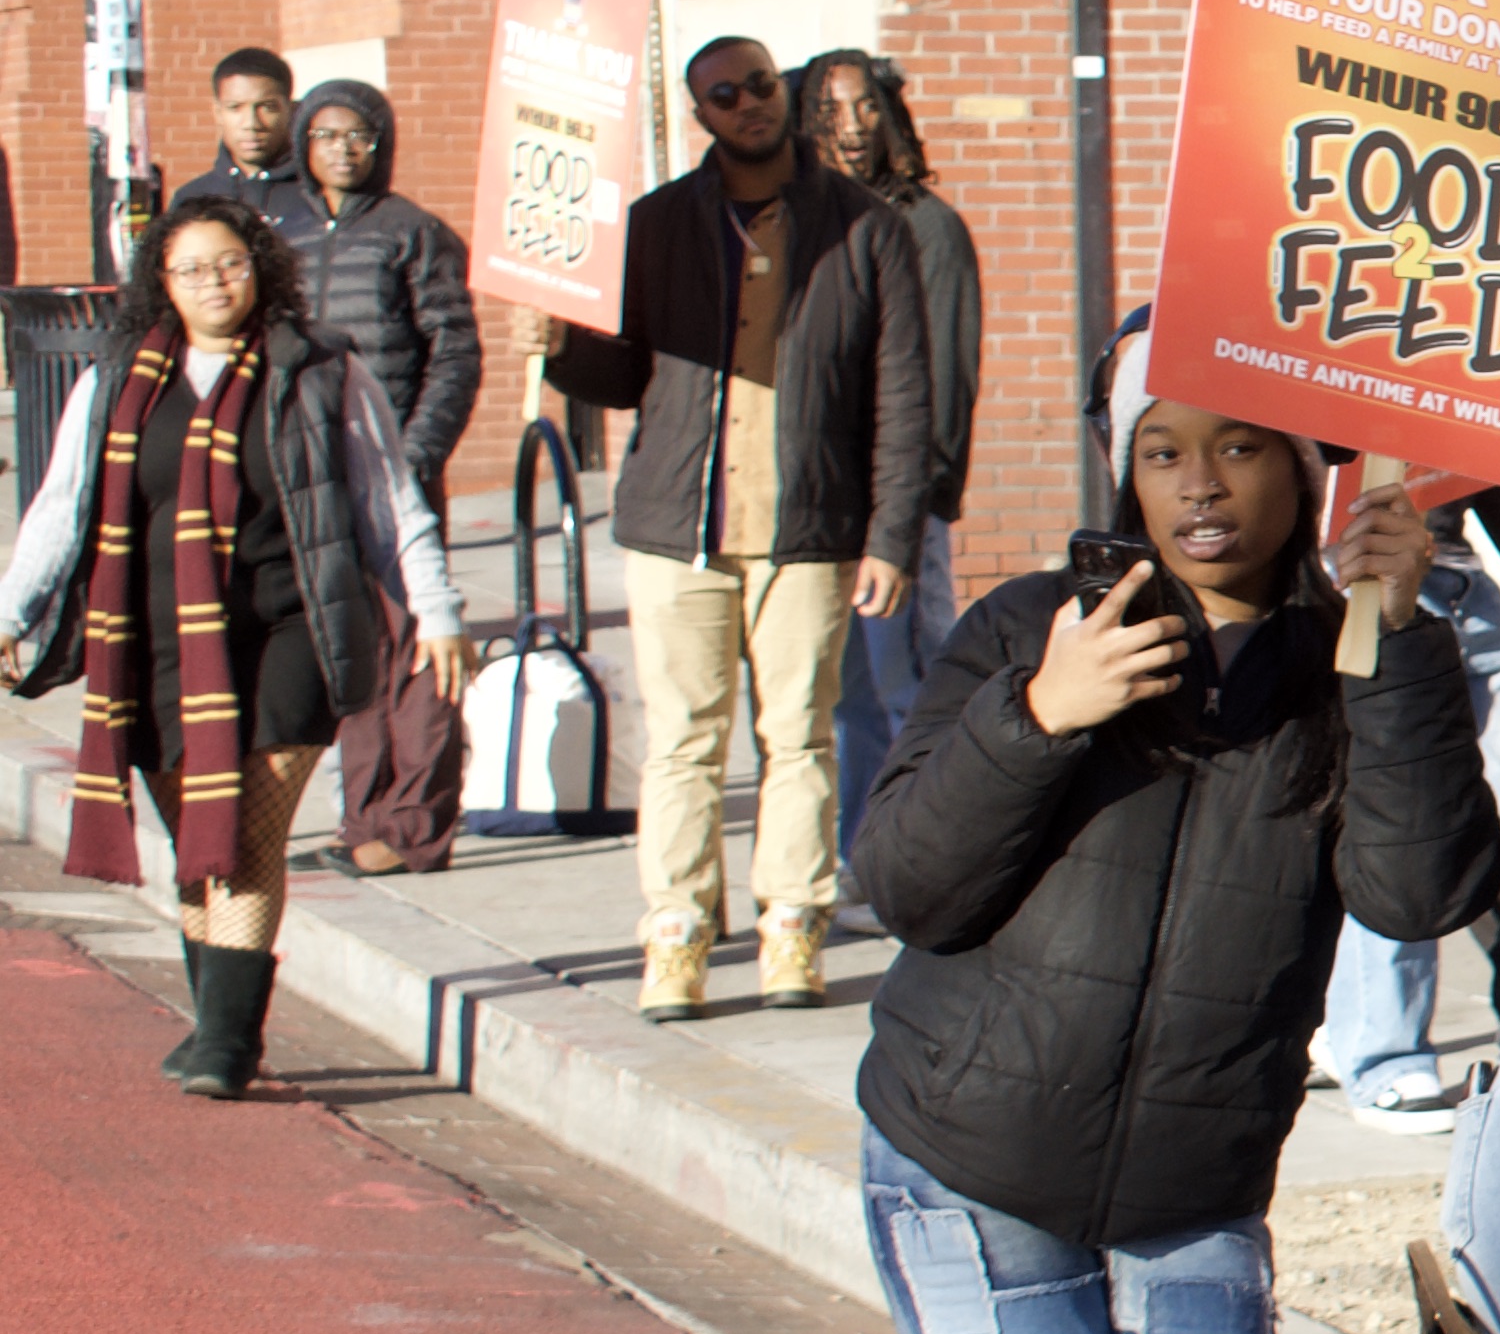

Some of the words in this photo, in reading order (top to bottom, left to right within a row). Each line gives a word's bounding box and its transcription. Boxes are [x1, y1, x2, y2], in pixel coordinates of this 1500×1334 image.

[1319, 10, 1372, 39] FEED
[1372, 25, 1390, 46] A
[1392, 30, 1463, 65] FAMILY
[1463, 50, 1492, 72] AT
[1295, 43, 1450, 125] WHUR
[1211, 335, 1308, 379] DONATE
[1310, 361, 1415, 406] ANYTIME
[1417, 389, 1449, 413] AT
